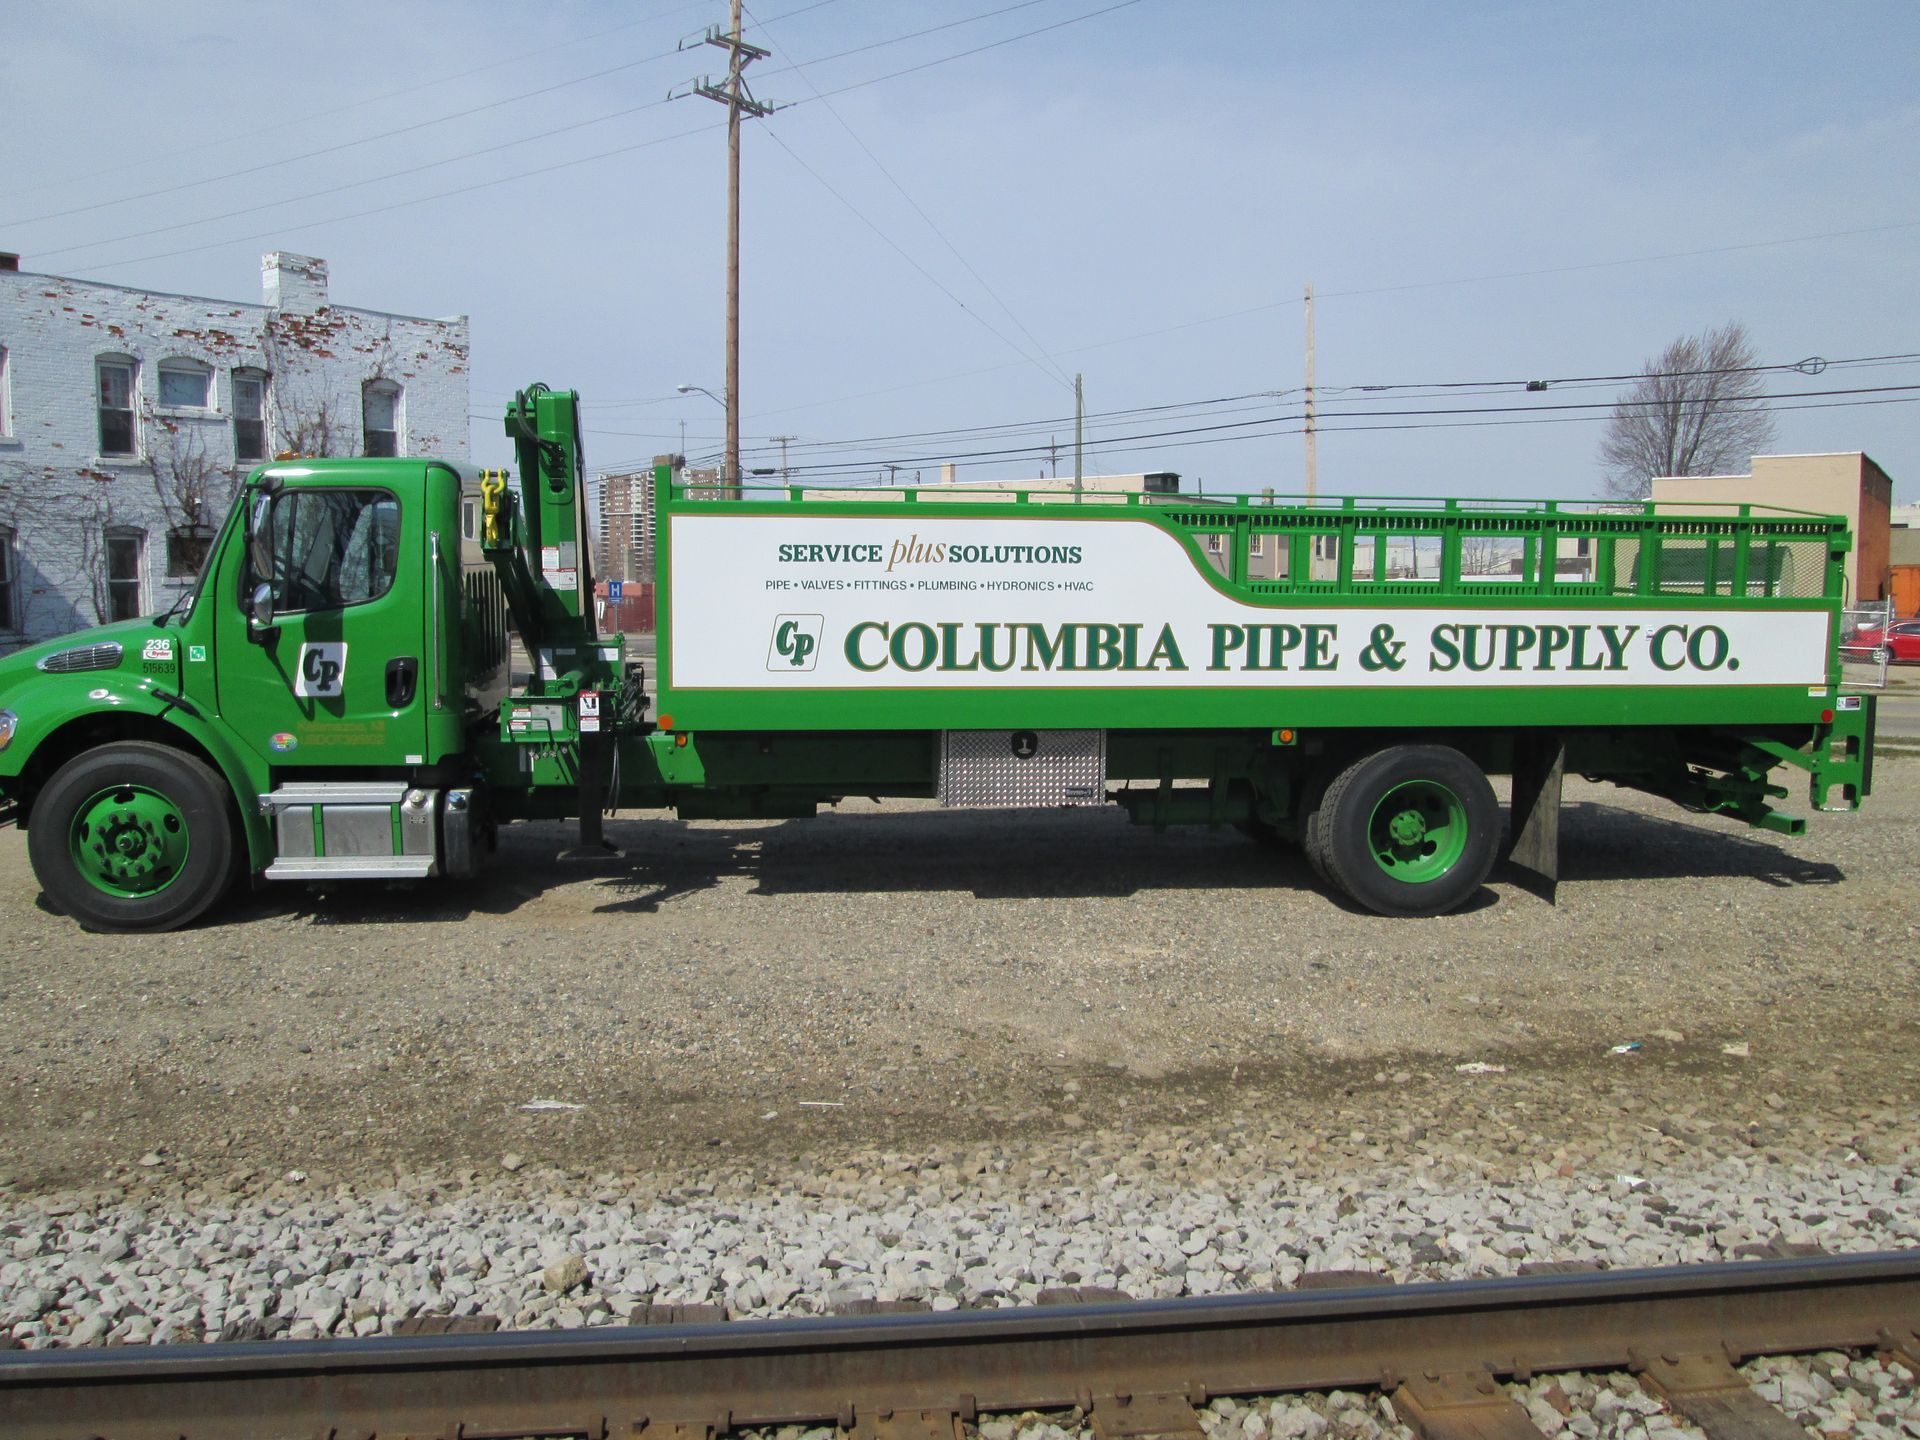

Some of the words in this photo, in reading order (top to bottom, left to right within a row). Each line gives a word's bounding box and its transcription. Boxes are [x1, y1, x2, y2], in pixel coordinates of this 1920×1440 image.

[778, 543, 882, 563] SERVICE
[885, 534, 946, 573] plus
[949, 545, 1083, 564] SOLUTIONS
[611, 584, 620, 597] H
[765, 579, 791, 590] PIPE
[800, 580, 844, 591] VALVES
[854, 580, 908, 591] FITTINGS
[917, 580, 977, 591] PLUMBING
[987, 581, 1055, 592] HYDRONICS
[1064, 581, 1094, 592] HVAC
[145, 639, 171, 650] 236
[775, 620, 815, 667] CP
[844, 622, 1189, 672] COLUMBIA
[1206, 624, 1339, 671] PIPE
[1359, 624, 1407, 671] &
[1429, 624, 1641, 671] SUPPLY
[1648, 624, 1740, 672] CO.
[151, 650, 170, 658] Ryder
[143, 662, 176, 674] 515639
[303, 648, 340, 692] CP
